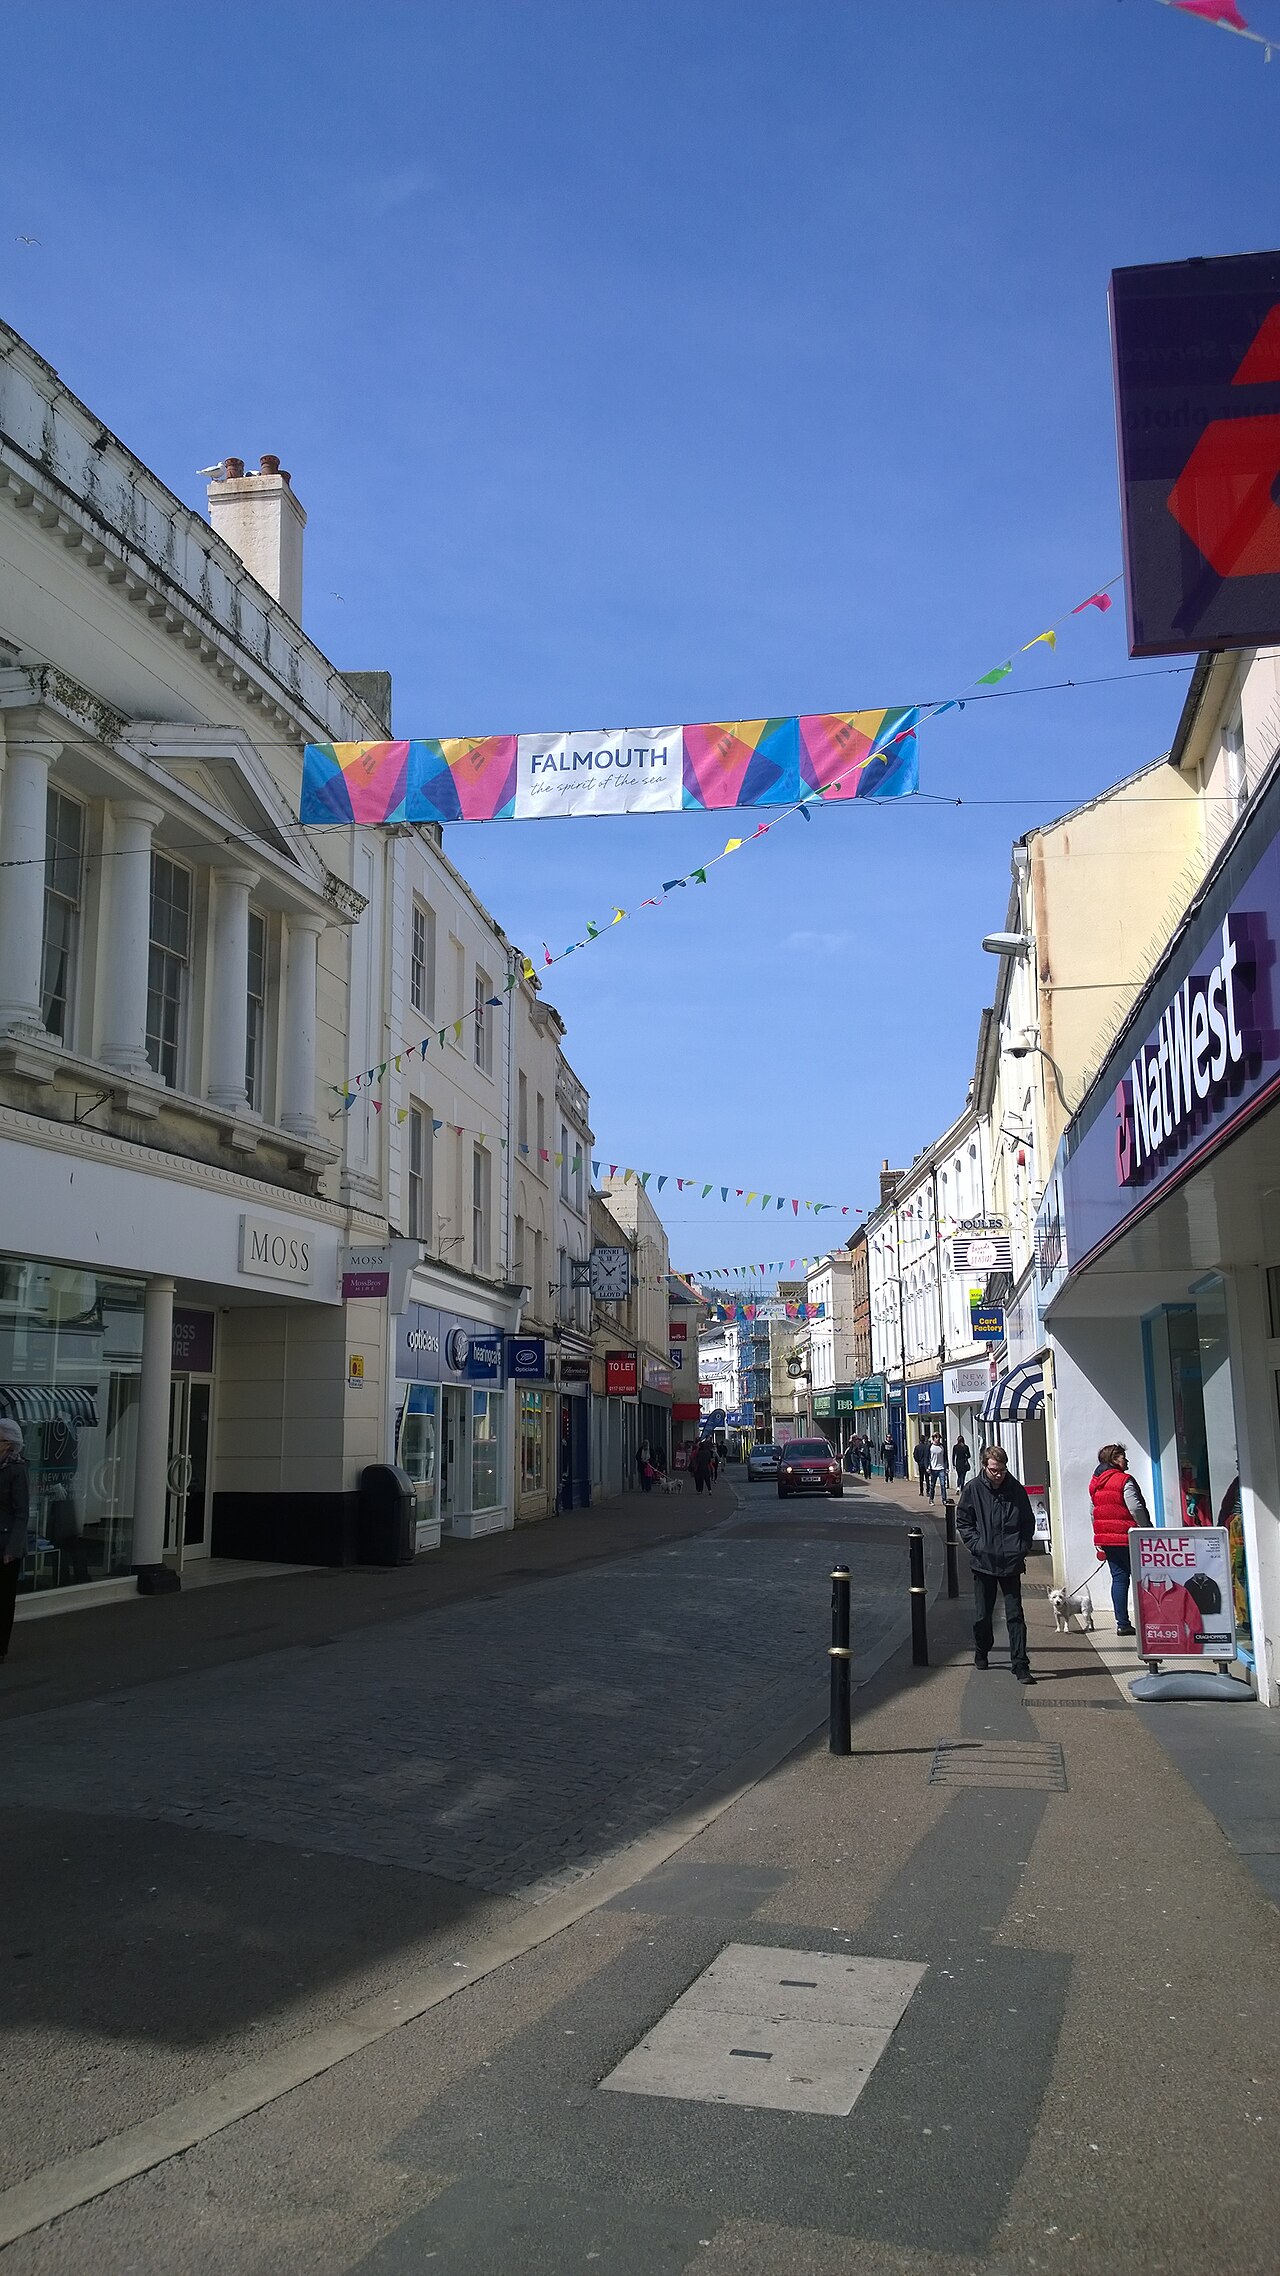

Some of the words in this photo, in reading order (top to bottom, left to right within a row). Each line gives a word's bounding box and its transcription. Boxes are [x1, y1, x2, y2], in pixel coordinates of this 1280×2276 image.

[531, 747, 668, 774] FALMOUTH
[530, 782, 553, 796] the
[556, 776, 597, 797] spirit
[598, 774, 614, 789] of
[614, 773, 639, 787] the
[641, 775, 668, 786] sea
[1131, 912, 1243, 1168] NatWest
[958, 1219, 1004, 1230] JOULES
[250, 1230, 310, 1272] MOSS
[350, 1256, 384, 1265] MOSS
[973, 1324, 1003, 1333] Factory
[979, 1317, 998, 1325] Card
[172, 1323, 196, 1340] OSS
[407, 1328, 439, 1353] opticians
[609, 1362, 620, 1371] TO
[620, 1362, 635, 1371] LET
[42, 1472, 60, 1482] NEW
[1140, 1537, 1190, 1552] HALF
[1141, 1552, 1197, 1567] PRICE
[1147, 1630, 1178, 1639] £14.99
